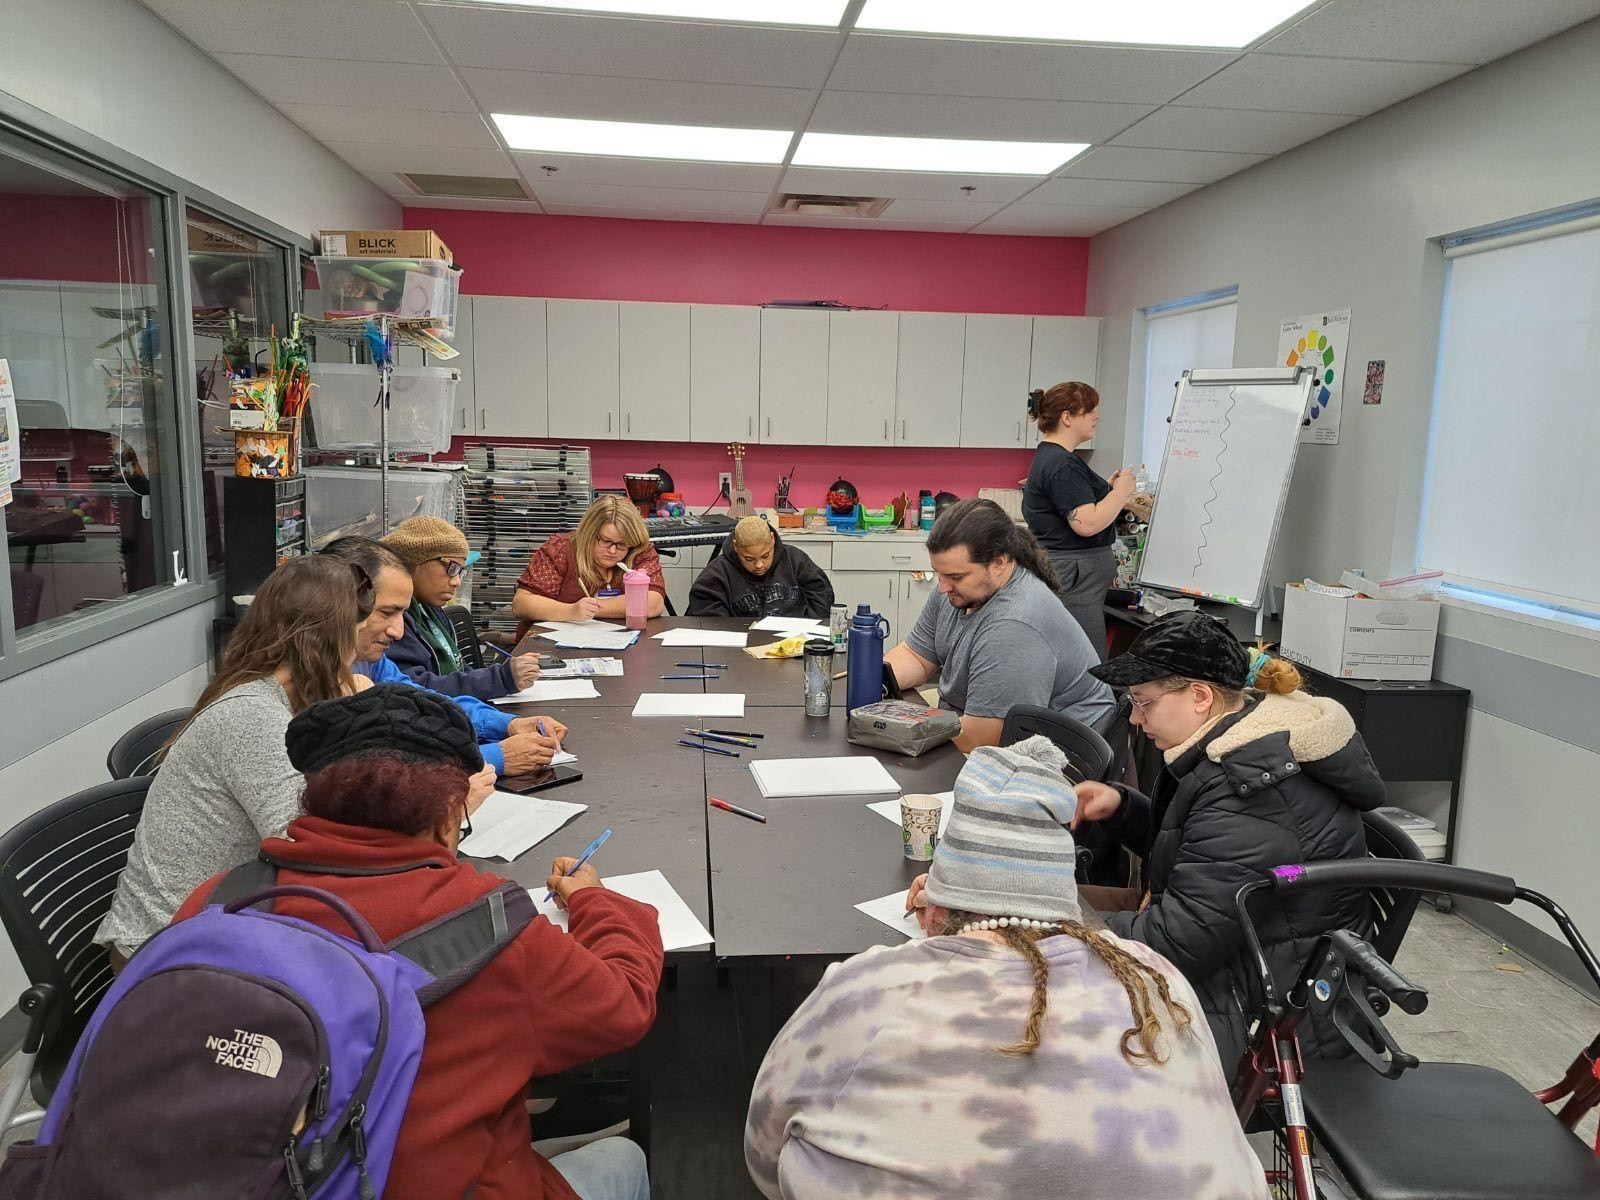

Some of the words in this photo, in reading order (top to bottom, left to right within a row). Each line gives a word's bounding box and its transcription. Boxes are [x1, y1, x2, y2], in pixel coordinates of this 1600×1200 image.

[359, 239, 396, 248] BLICK
[234, 1029, 264, 1046] THE
[205, 1035, 260, 1059] NORTH
[215, 1051, 255, 1071] FACE
